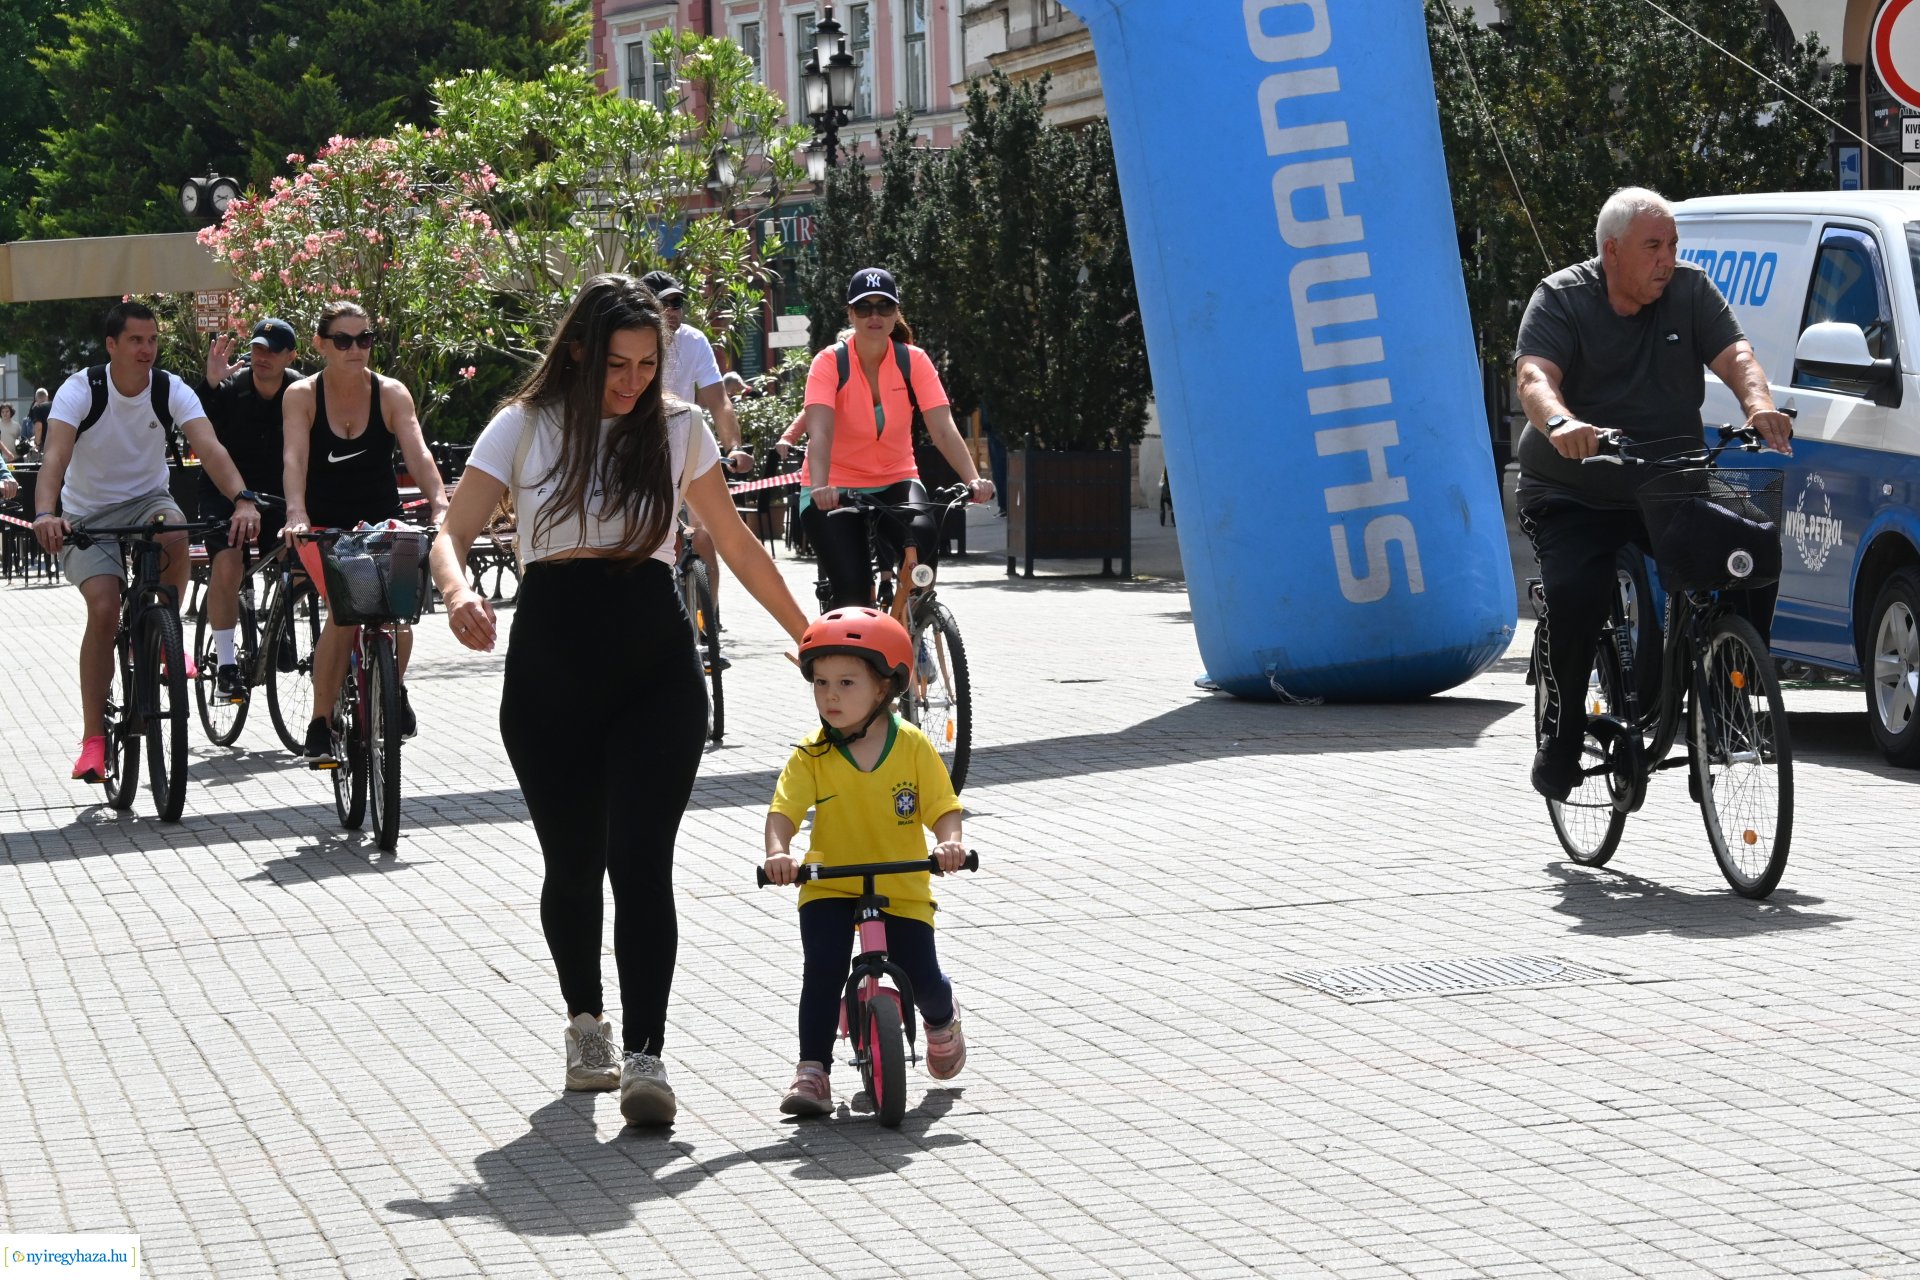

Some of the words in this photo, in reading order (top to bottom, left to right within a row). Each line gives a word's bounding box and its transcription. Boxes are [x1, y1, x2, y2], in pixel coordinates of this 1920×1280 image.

[866, 273, 881, 288] NY
[1241, 0, 1425, 604] SHIMANO
[1680, 249, 1778, 306] MANO
[1616, 625, 1634, 673] VELENCE
